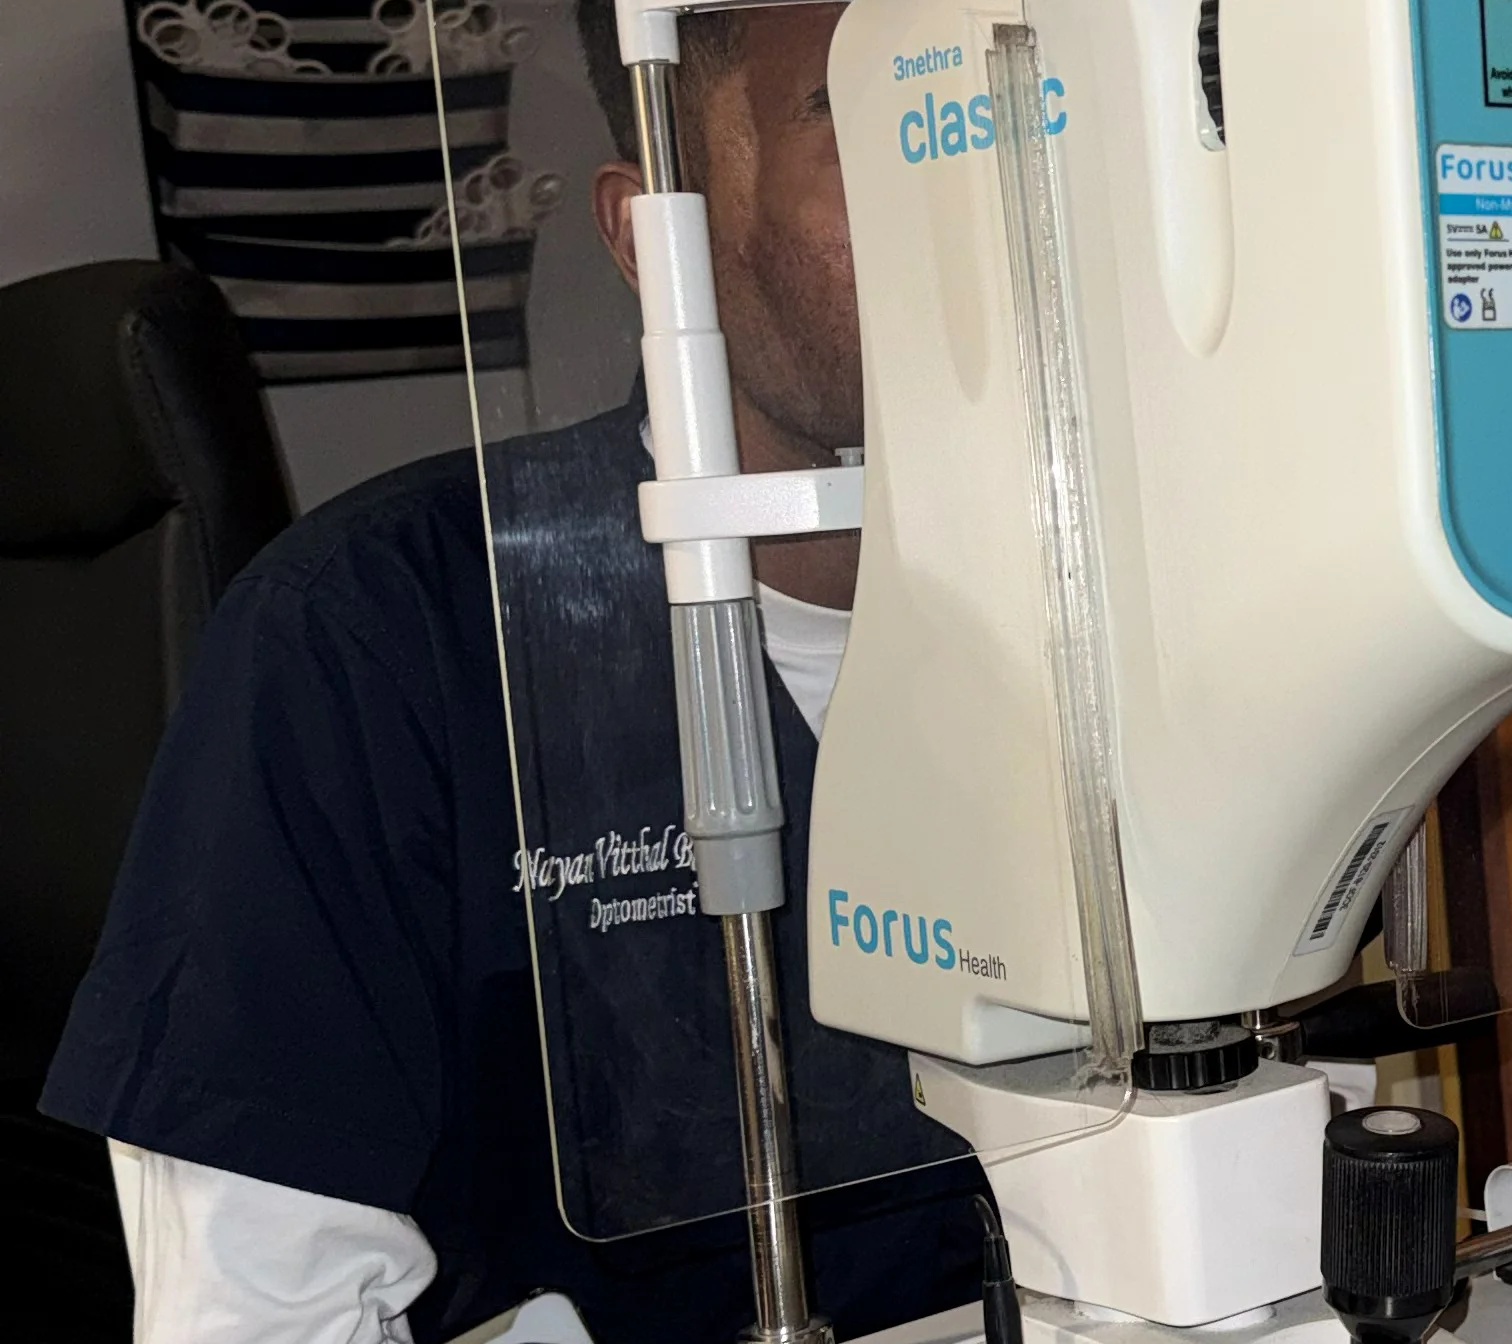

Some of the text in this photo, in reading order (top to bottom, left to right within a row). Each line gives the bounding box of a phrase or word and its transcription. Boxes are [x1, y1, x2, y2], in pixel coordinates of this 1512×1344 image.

[893, 45, 963, 82] 3nethra
[900, 77, 1068, 164] clasc
[1446, 248, 1462, 258] Use
[1464, 249, 1482, 260] only
[1484, 248, 1507, 258] Forus
[1447, 261, 1512, 272] approved power
[589, 886, 697, 933] Optometrist
[828, 888, 1008, 981] Forus Health
